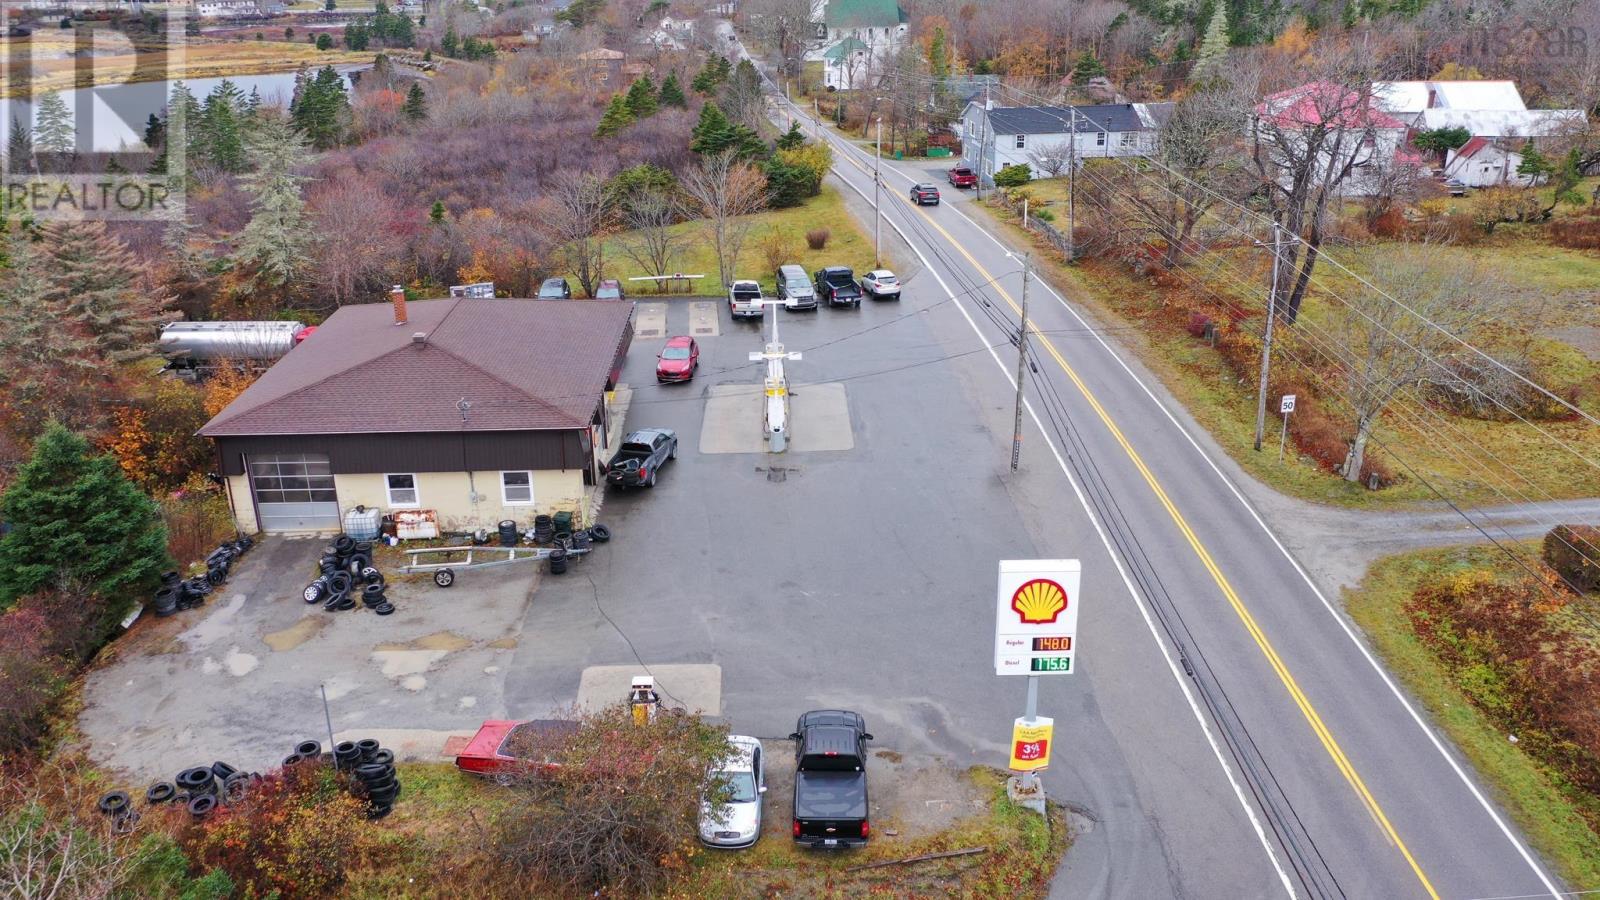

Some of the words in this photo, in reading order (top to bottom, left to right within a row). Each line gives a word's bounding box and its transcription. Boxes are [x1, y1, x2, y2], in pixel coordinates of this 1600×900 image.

[1283, 401, 1293, 410] 50
[1039, 638, 1069, 650] 148.0
[1038, 658, 1068, 670] 175.6
